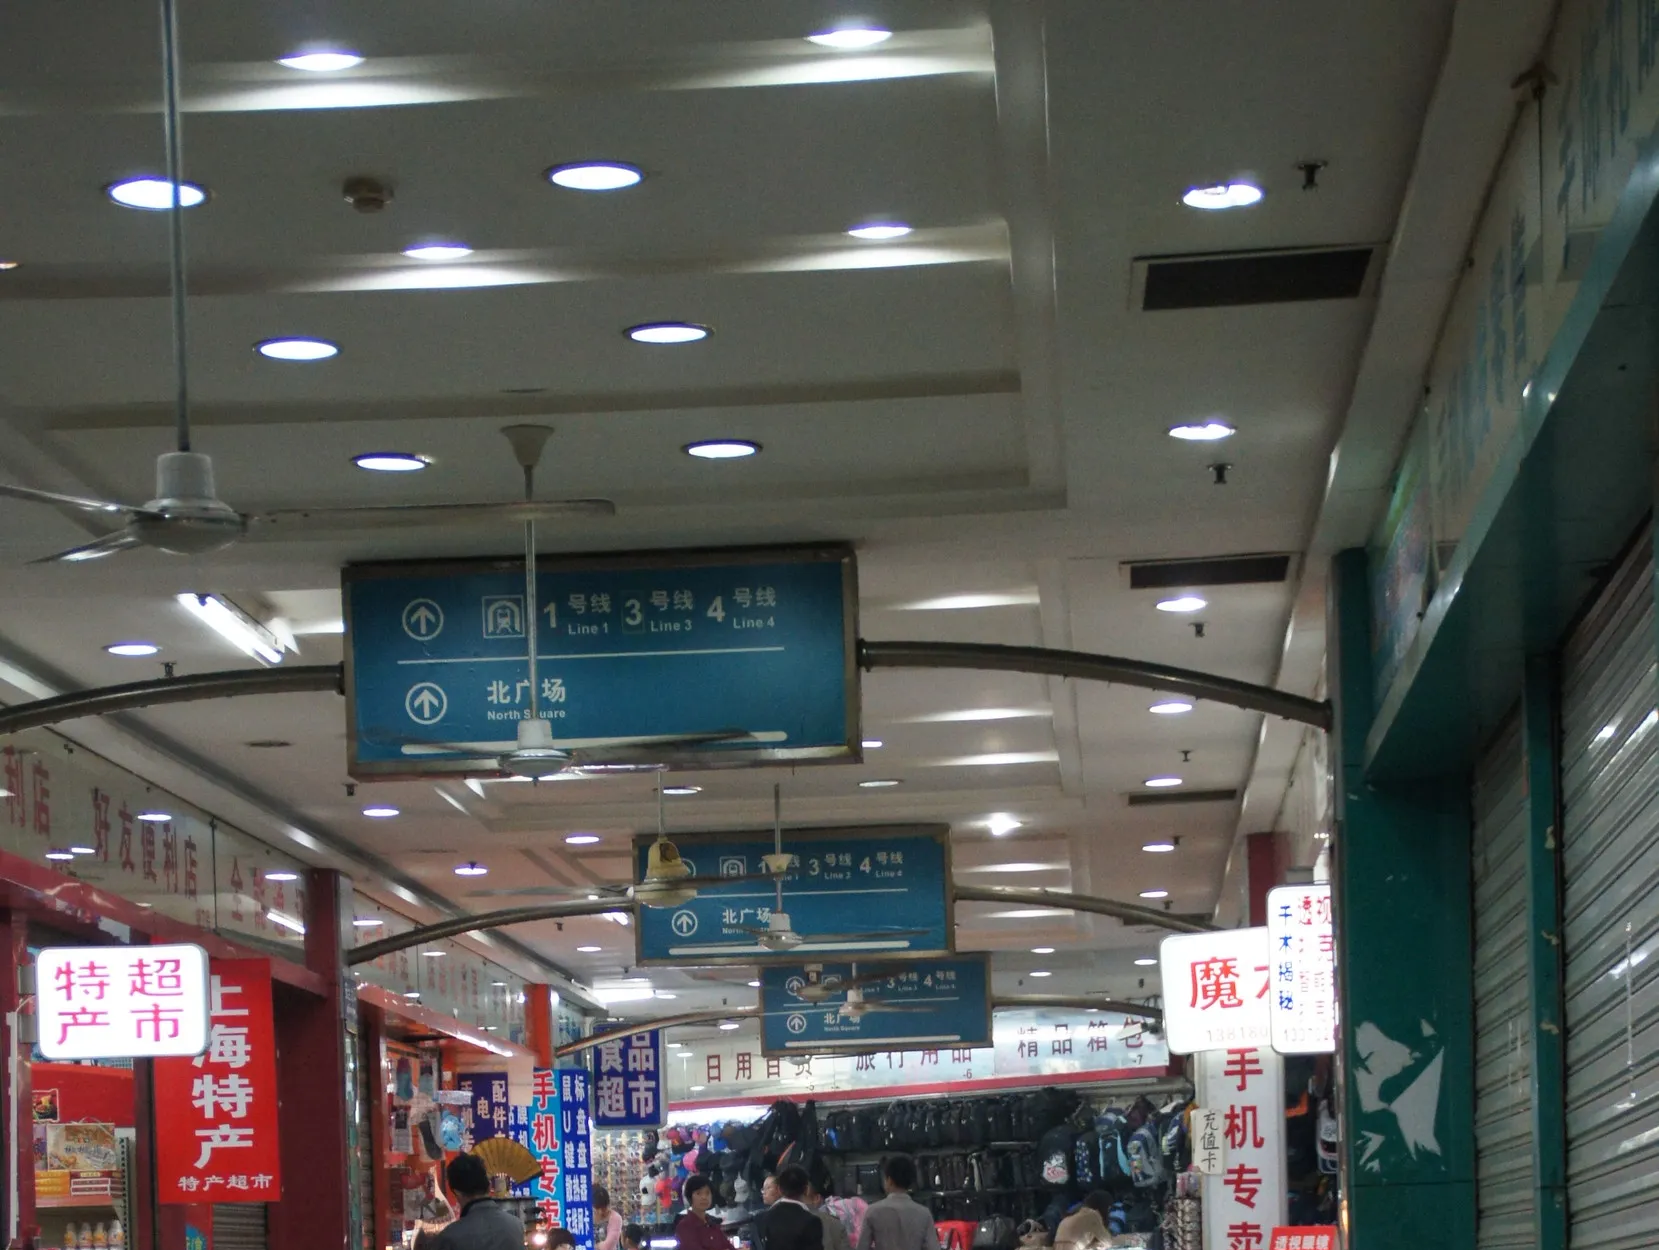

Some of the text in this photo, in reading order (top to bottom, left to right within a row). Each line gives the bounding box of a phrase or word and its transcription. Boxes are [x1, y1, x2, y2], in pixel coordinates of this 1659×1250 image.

[544, 587, 776, 628] 1 号线 3 号线 4 号线
[568, 617, 775, 635] Line 1 Line 3 Line 4
[487, 679, 566, 704] 北广场
[487, 709, 566, 721] North Suare
[809, 857, 820, 876] 3
[824, 853, 852, 867] 号线
[859, 856, 871, 873] 4
[876, 851, 903, 865] 号线
[824, 871, 842, 880] Line
[876, 870, 894, 878] Line
[722, 907, 772, 924] 北广场
[887, 977, 895, 989] 3
[923, 975, 932, 987] 4
[1190, 956, 1269, 1010] 魔
[191, 974, 254, 1169] 上海特产
[597, 1075, 655, 1118] 超市
[563, 1108, 587, 1135] U盘
[533, 1071, 560, 1229] 手机专卖
[1200, 1111, 1219, 1171] 充值卡
[178, 1174, 273, 1192] 特产超市
